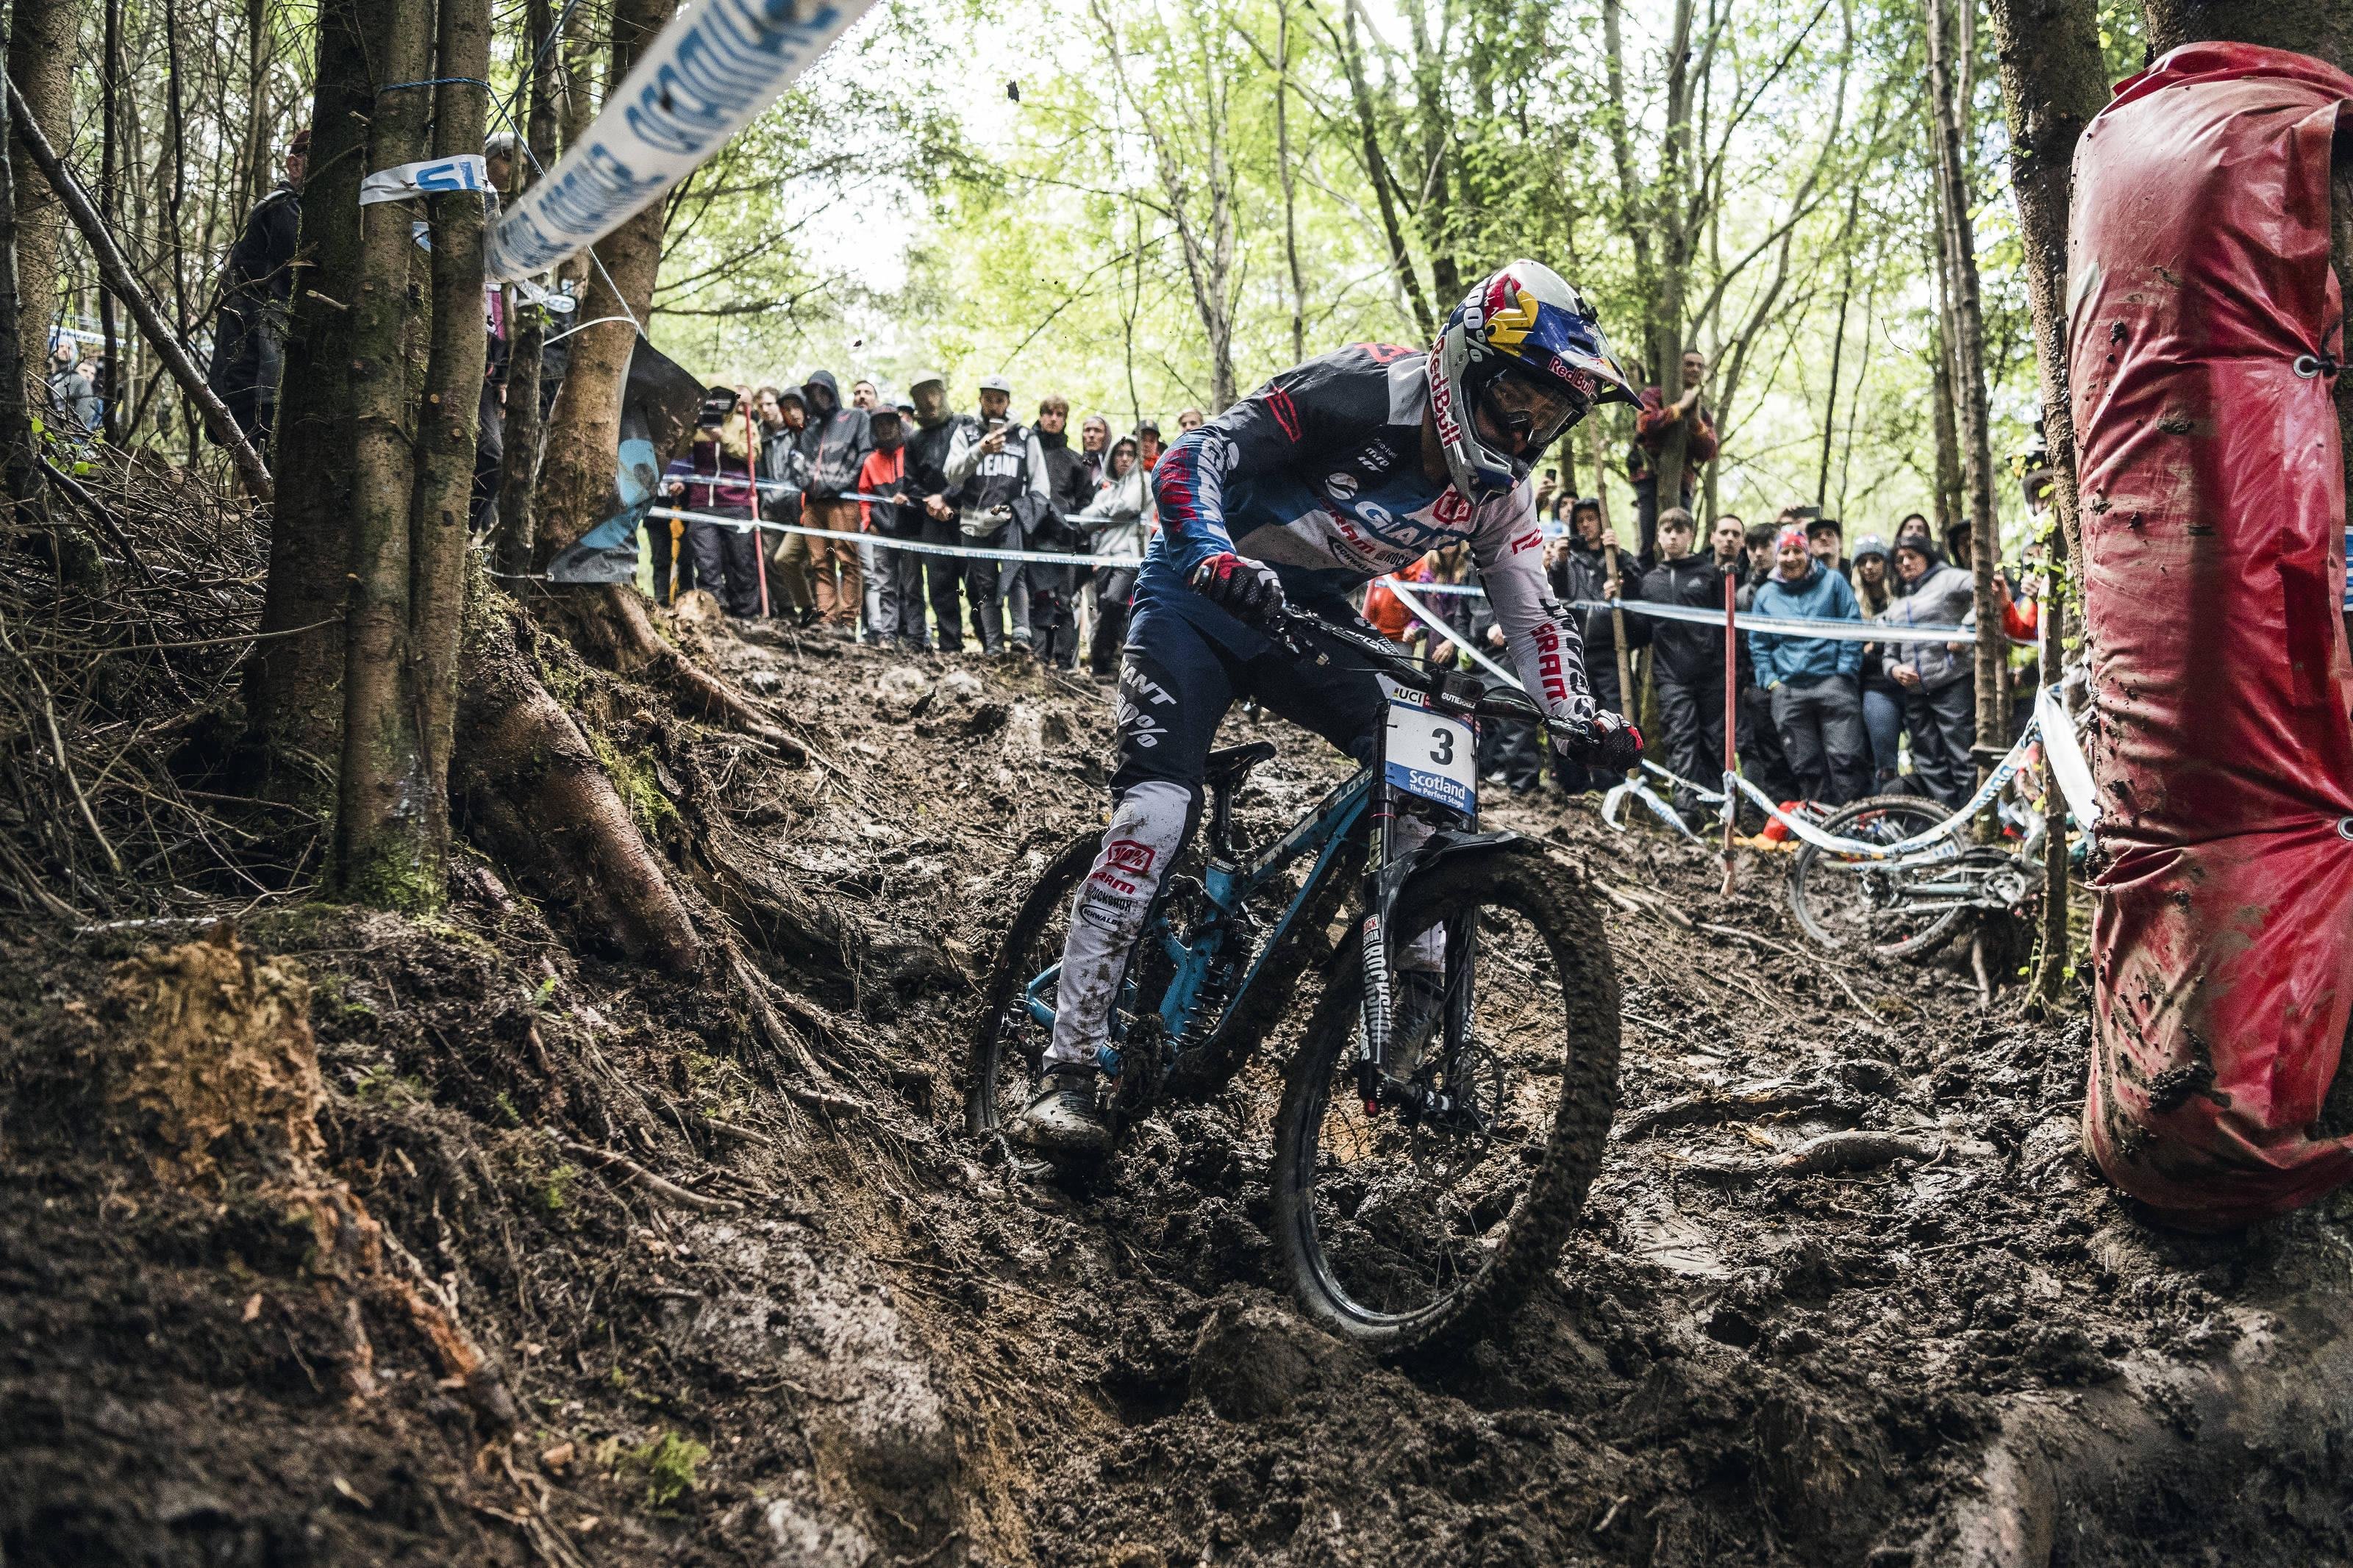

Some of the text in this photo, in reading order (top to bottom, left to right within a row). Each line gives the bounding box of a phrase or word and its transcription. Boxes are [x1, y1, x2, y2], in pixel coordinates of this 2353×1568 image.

[1429, 335, 1463, 449] Red Bull
[1548, 355, 1596, 397] Red Bull
[1119, 654, 1177, 705] IANT
[1399, 688, 1423, 704] UCI
[1429, 728, 1454, 765] 3
[1409, 770, 1465, 801] Scotland
[1409, 783, 1465, 809] The Perfect Stage
